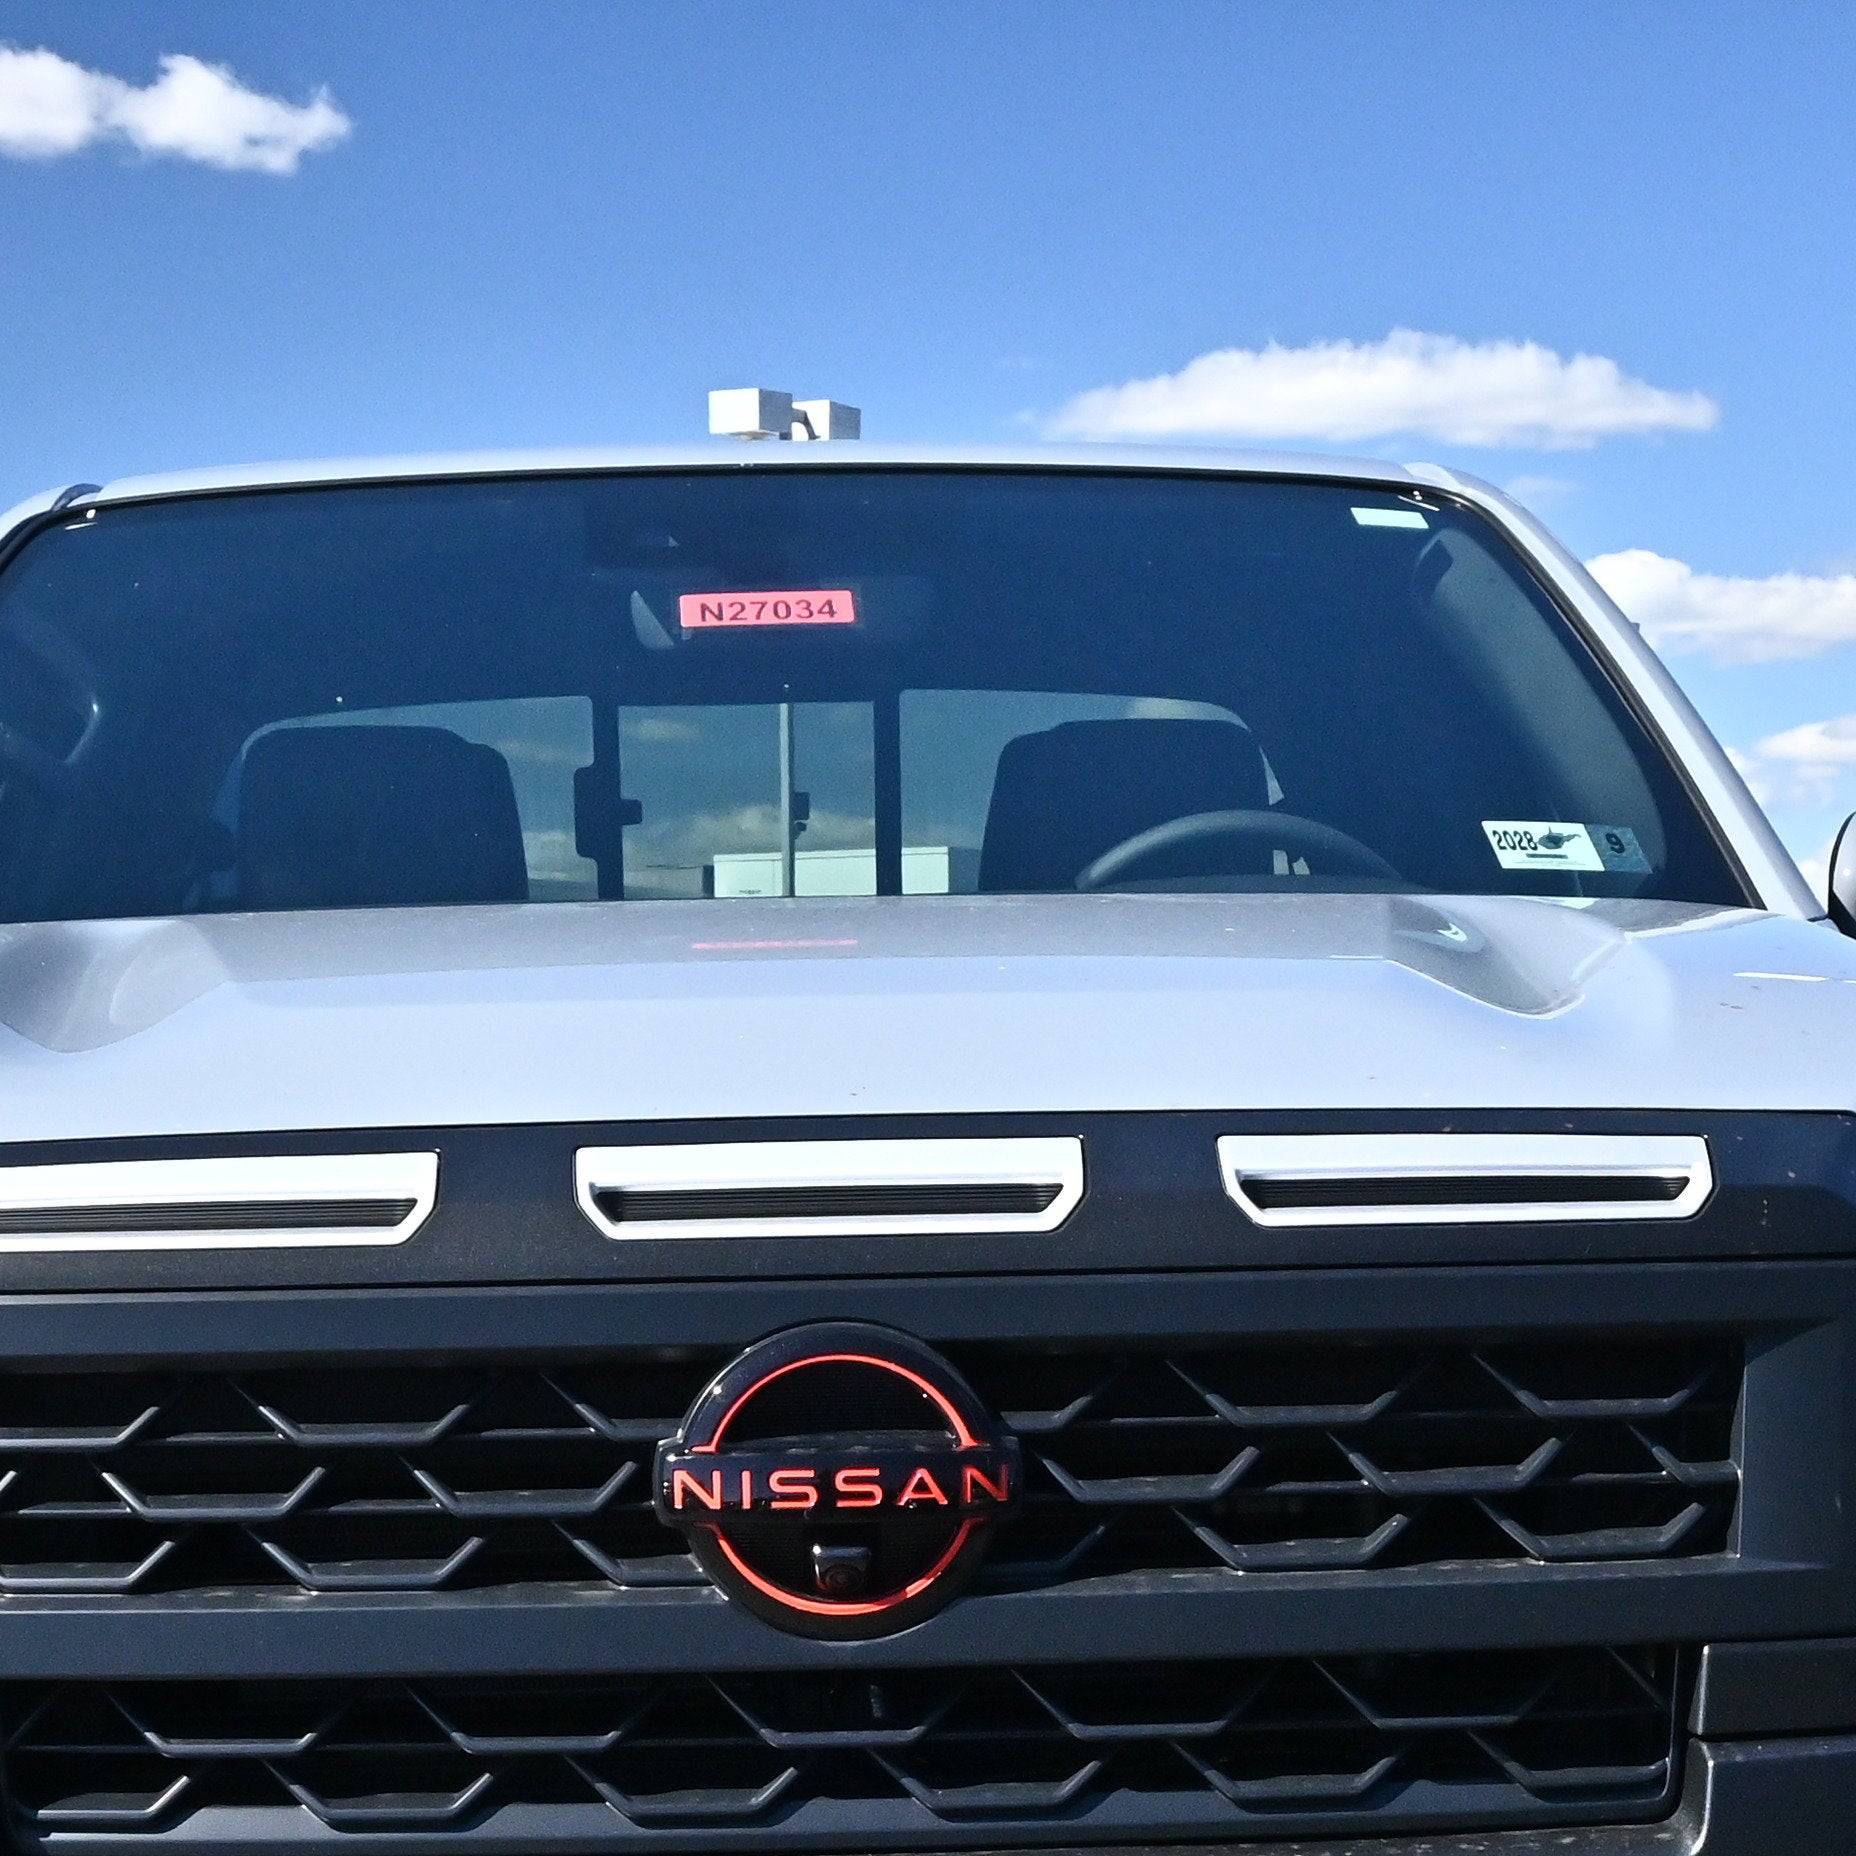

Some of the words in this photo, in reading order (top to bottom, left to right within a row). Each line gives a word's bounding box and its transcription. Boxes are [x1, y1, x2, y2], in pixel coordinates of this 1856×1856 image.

[700, 599, 838, 622] N27034
[1492, 829, 1539, 852] 2028
[672, 1464, 1010, 1510] NISSAN
